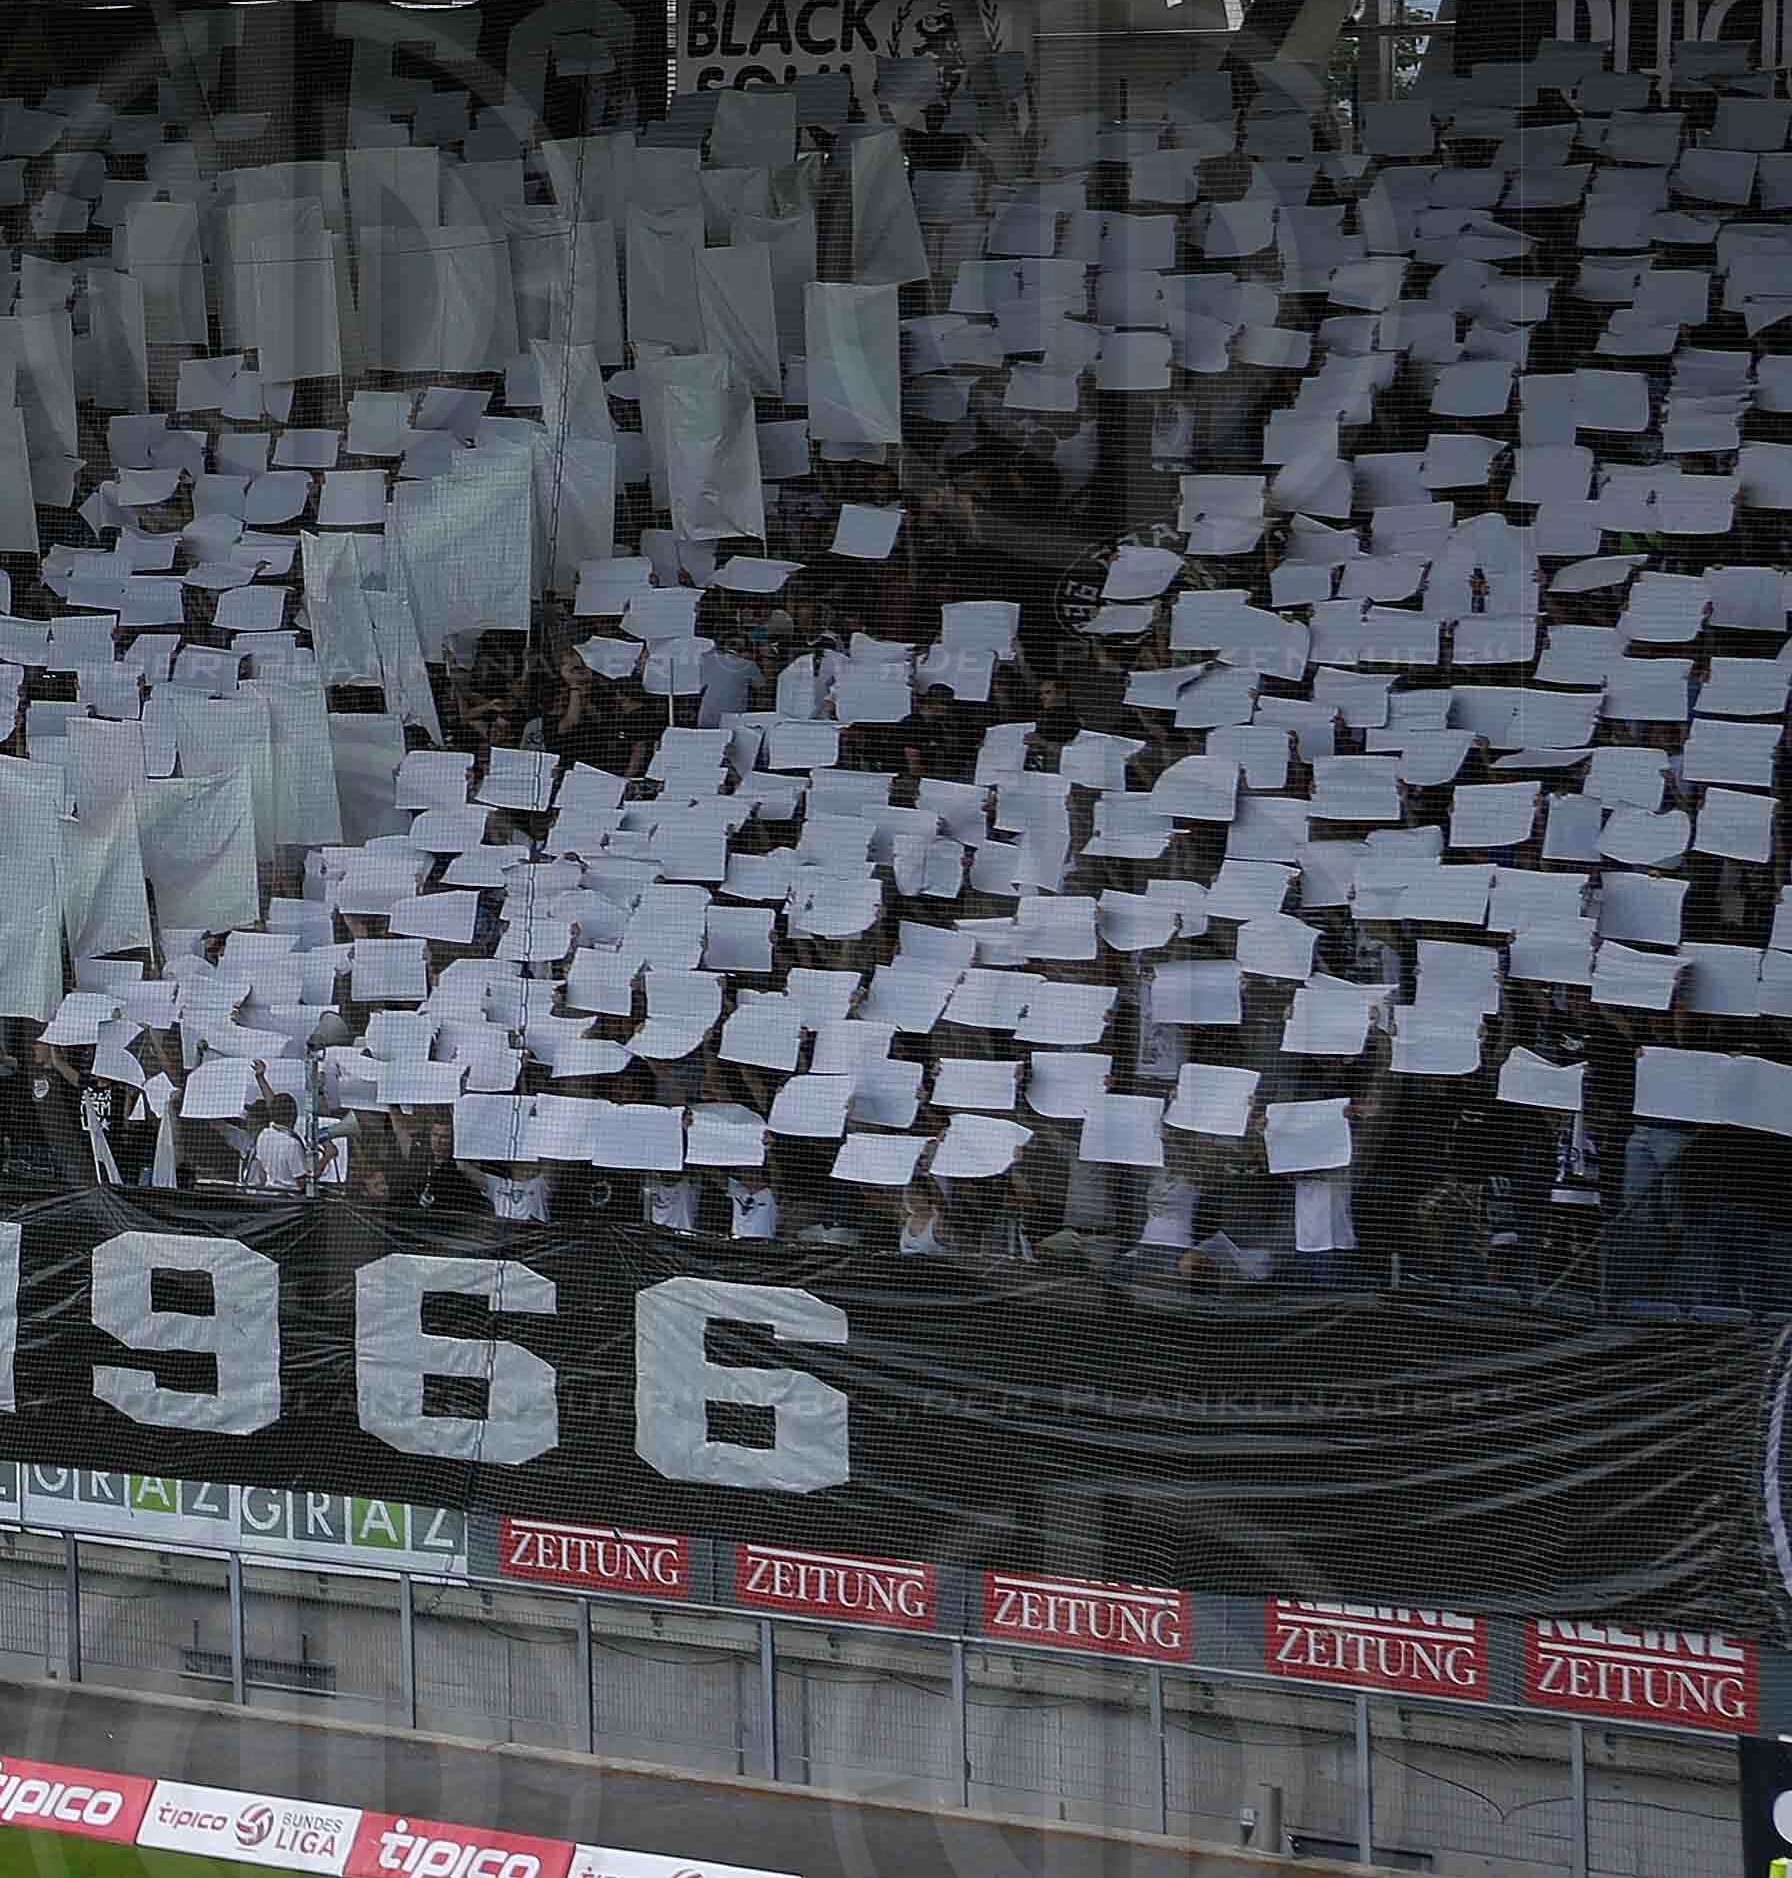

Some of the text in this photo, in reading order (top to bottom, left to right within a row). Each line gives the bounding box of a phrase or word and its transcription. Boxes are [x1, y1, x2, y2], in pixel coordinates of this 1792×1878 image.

[508, 1528, 681, 1587] ZEITUNG
[745, 1555, 926, 1619] ZEITUNG
[992, 1585, 1182, 1650] ZEITUNG
[1276, 1623, 1477, 1686] ZEITUNG
[1537, 1652, 1747, 1720] ZEITUNG
[157, 1801, 228, 1833] tipico
[275, 1828, 337, 1860] LIGA
[281, 1810, 344, 1834] BUNDES
[376, 1814, 542, 1878] tipico
